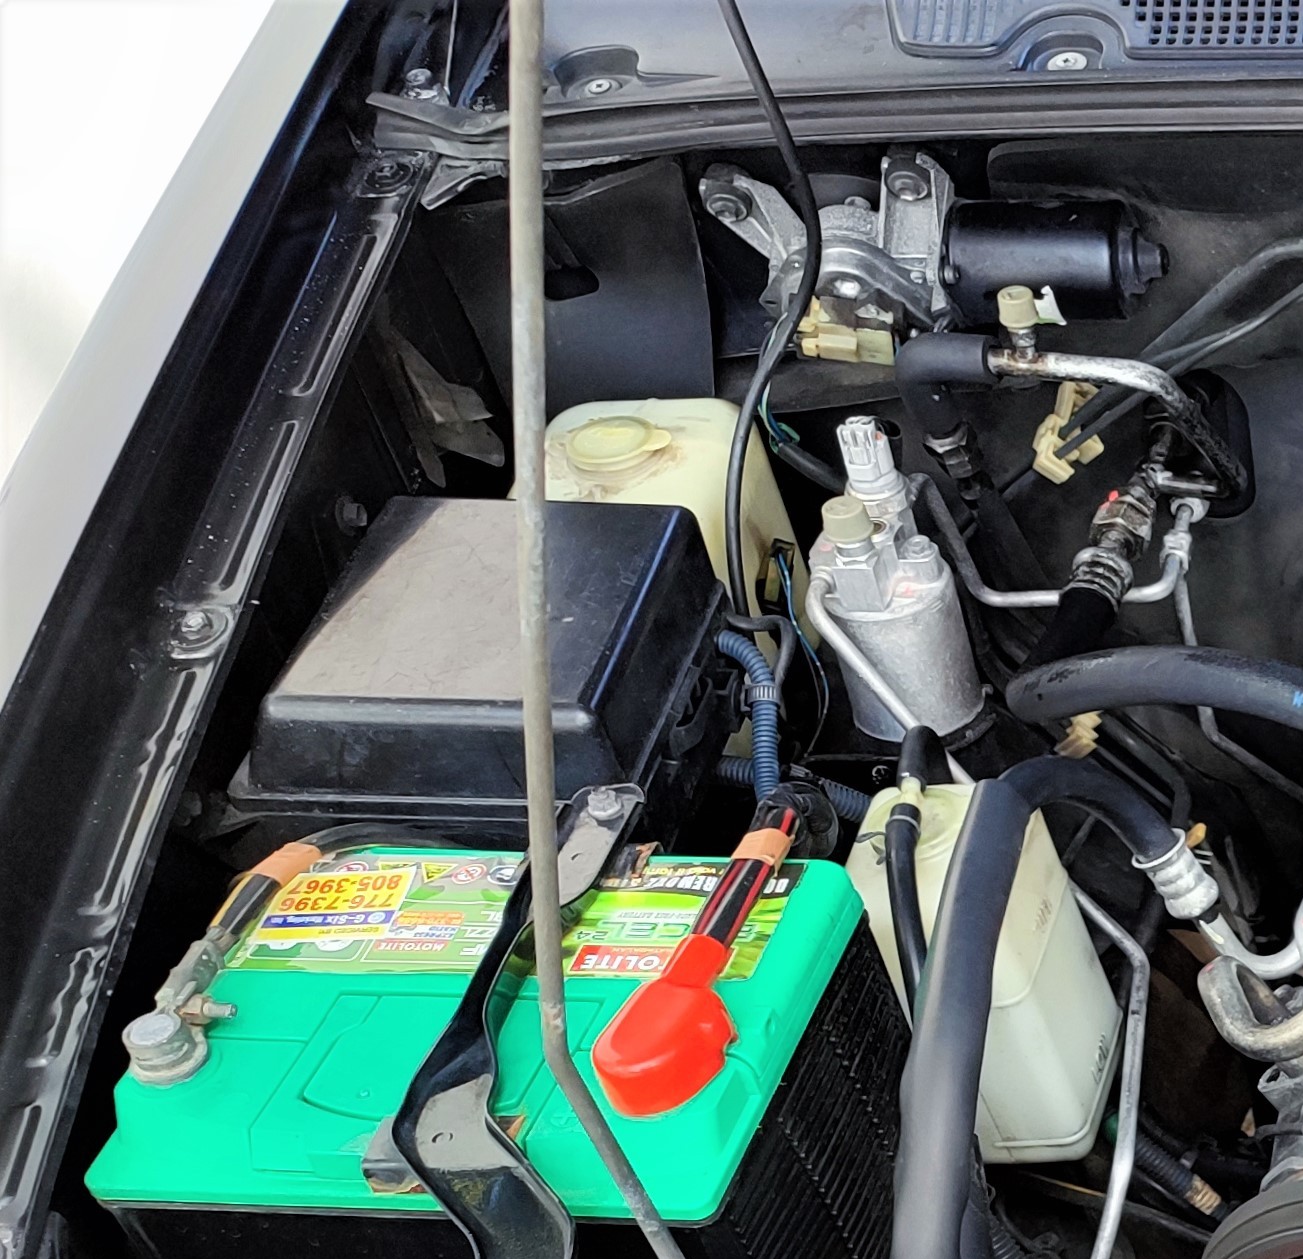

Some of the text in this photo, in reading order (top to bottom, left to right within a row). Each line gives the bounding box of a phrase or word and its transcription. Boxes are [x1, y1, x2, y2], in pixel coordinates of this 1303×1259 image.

[287, 874, 403, 895] 805-3967
[279, 893, 394, 912] 776-7396
[576, 931, 608, 940] 24
[378, 942, 446, 951] MOTOLITE
[581, 953, 665, 970] OLITE
